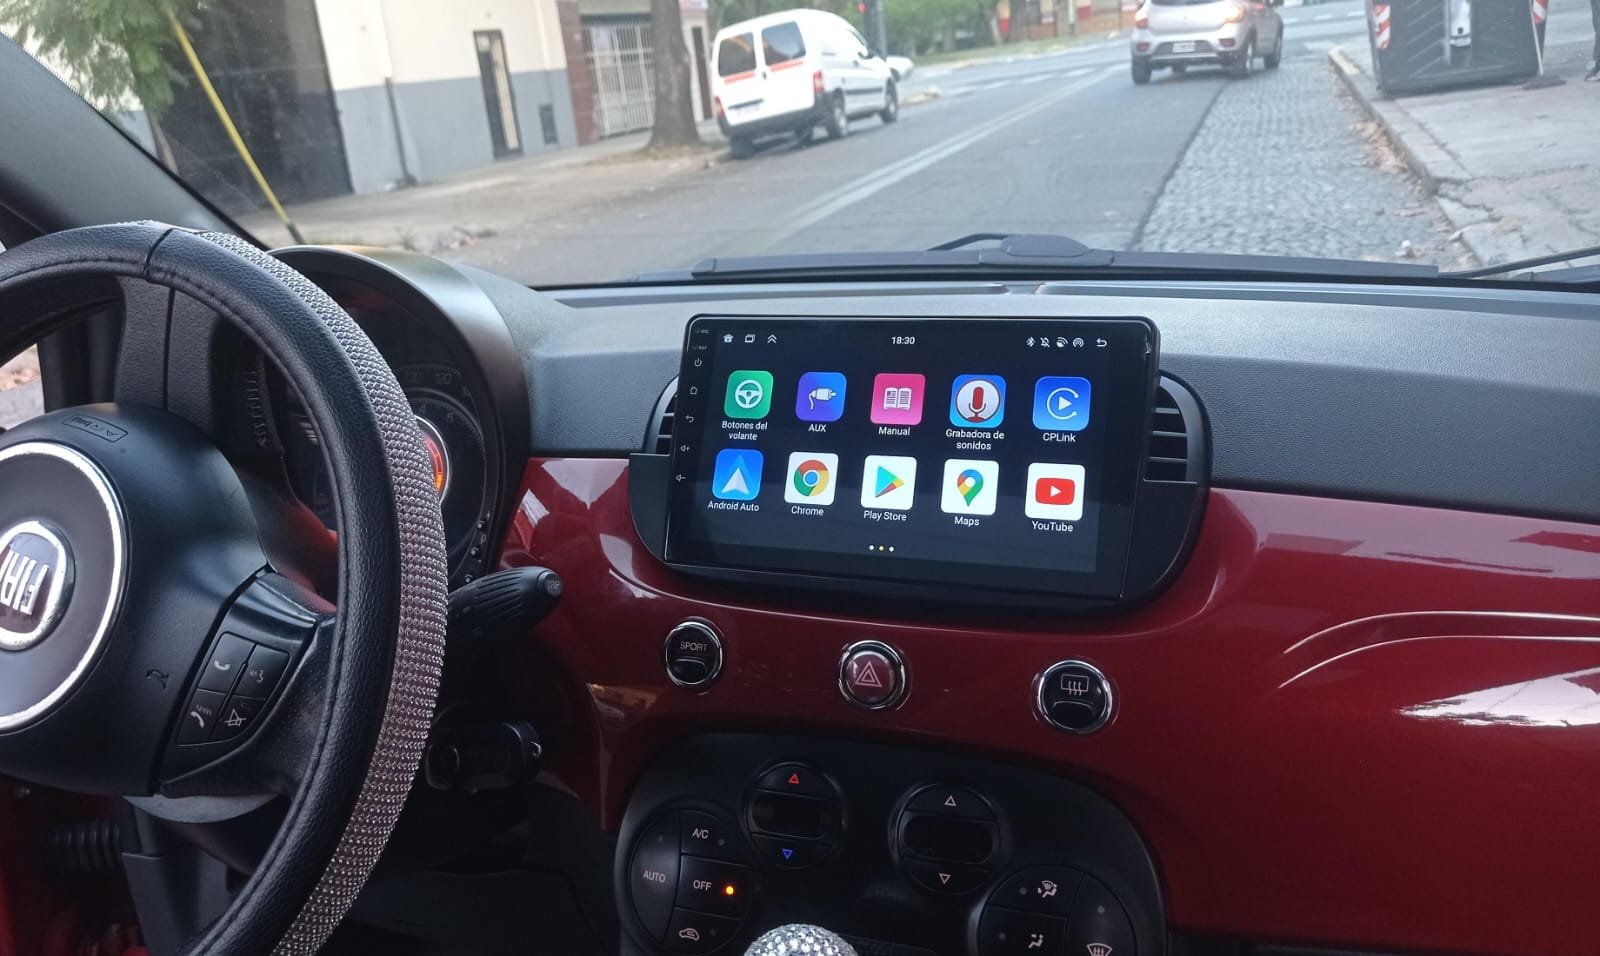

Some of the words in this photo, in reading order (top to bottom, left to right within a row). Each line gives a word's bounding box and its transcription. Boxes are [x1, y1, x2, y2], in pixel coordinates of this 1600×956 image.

[891, 336, 915, 345] 18:30
[721, 420, 754, 430] Botones
[755, 421, 768, 430] del
[808, 424, 826, 433] AUX
[728, 431, 758, 440] volante
[878, 427, 910, 436] Manual
[945, 428, 992, 439] Grabadora
[993, 430, 1005, 439] de
[1042, 432, 1076, 442] CPLink
[956, 440, 992, 450] sonidos
[707, 501, 738, 510] Android
[739, 502, 760, 512] Auto
[791, 505, 824, 516] Chrome
[863, 510, 882, 521] Play
[883, 512, 907, 521] Store
[954, 516, 980, 527] Maps
[1032, 521, 1074, 532] YouTube
[680, 641, 709, 652] SPORT
[692, 828, 709, 839] A/C
[643, 870, 666, 883] AUTO
[693, 880, 712, 891] OFF
